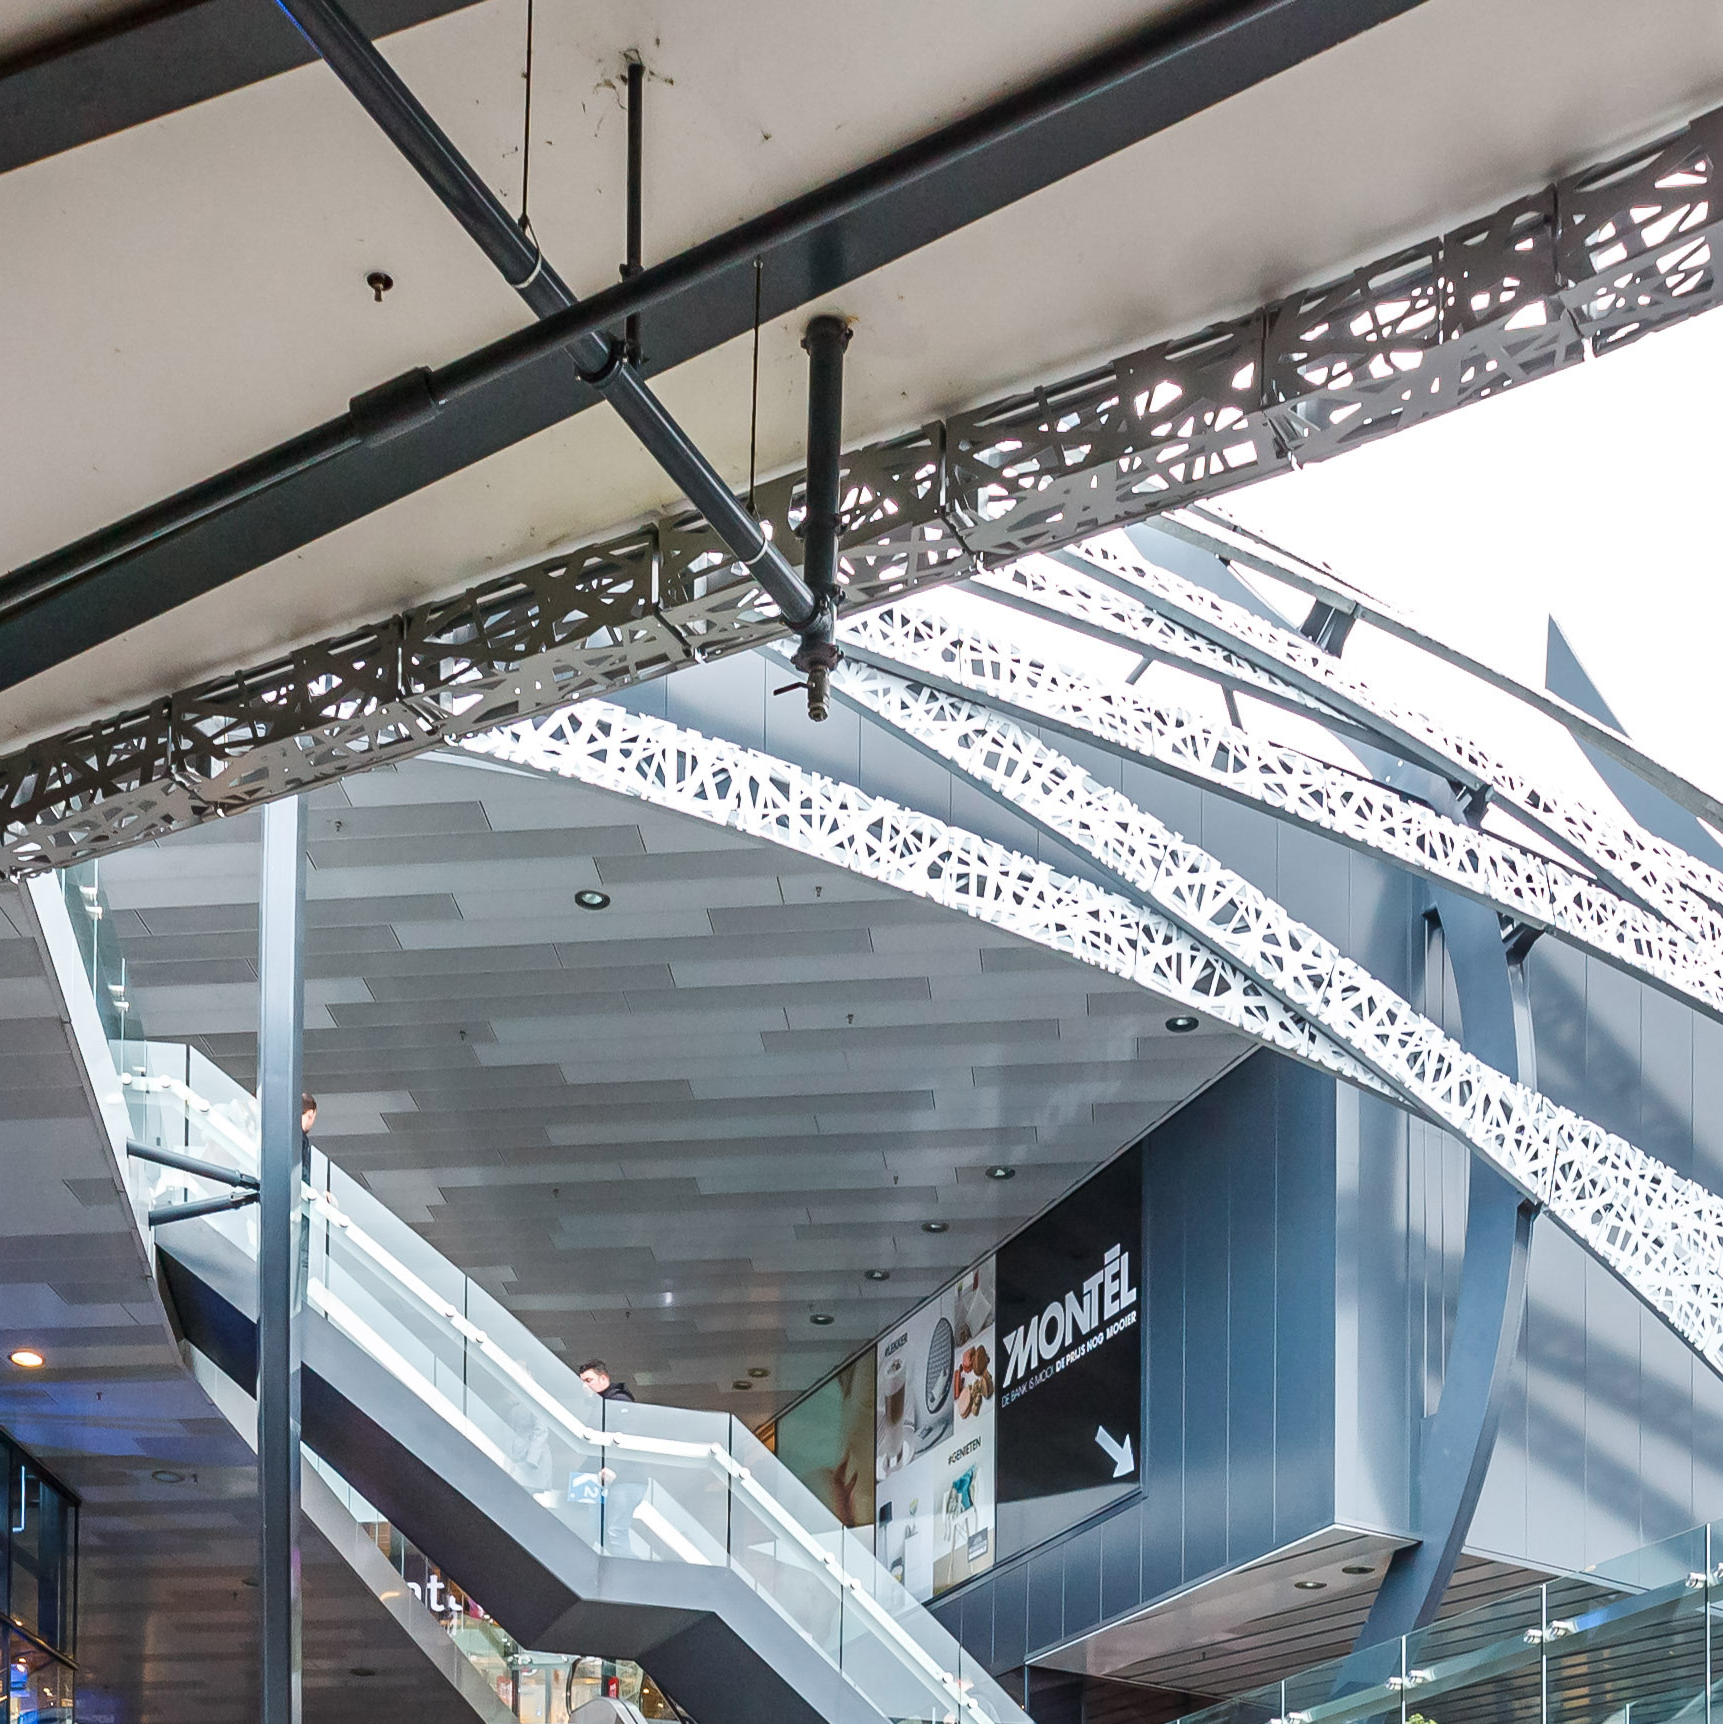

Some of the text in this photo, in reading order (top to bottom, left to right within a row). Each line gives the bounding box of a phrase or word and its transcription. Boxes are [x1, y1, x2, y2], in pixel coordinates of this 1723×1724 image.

[1056, 1358, 1066, 1372] DE
[1066, 1345, 1086, 1366] PRIJS
[1087, 1332, 1104, 1353] NOG
[1106, 1311, 1137, 1339] MOOIER
